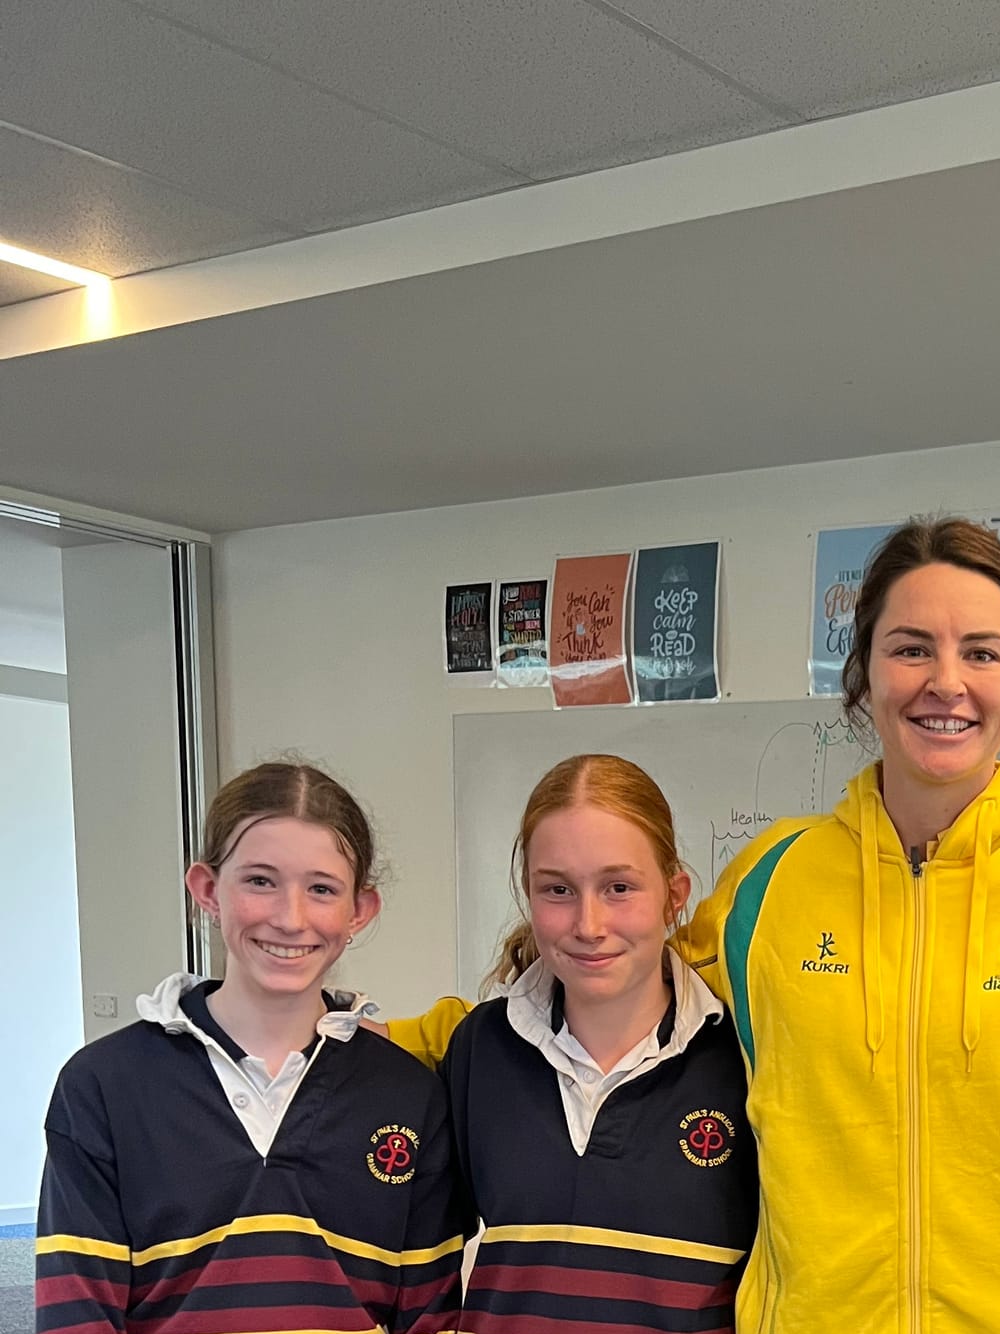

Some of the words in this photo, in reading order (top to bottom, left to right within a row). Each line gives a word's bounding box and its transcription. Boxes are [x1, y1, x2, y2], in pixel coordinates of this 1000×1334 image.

[653, 613, 697, 632] calm
[731, 808, 774, 825] Health
[801, 959, 849, 975] KUKRI
